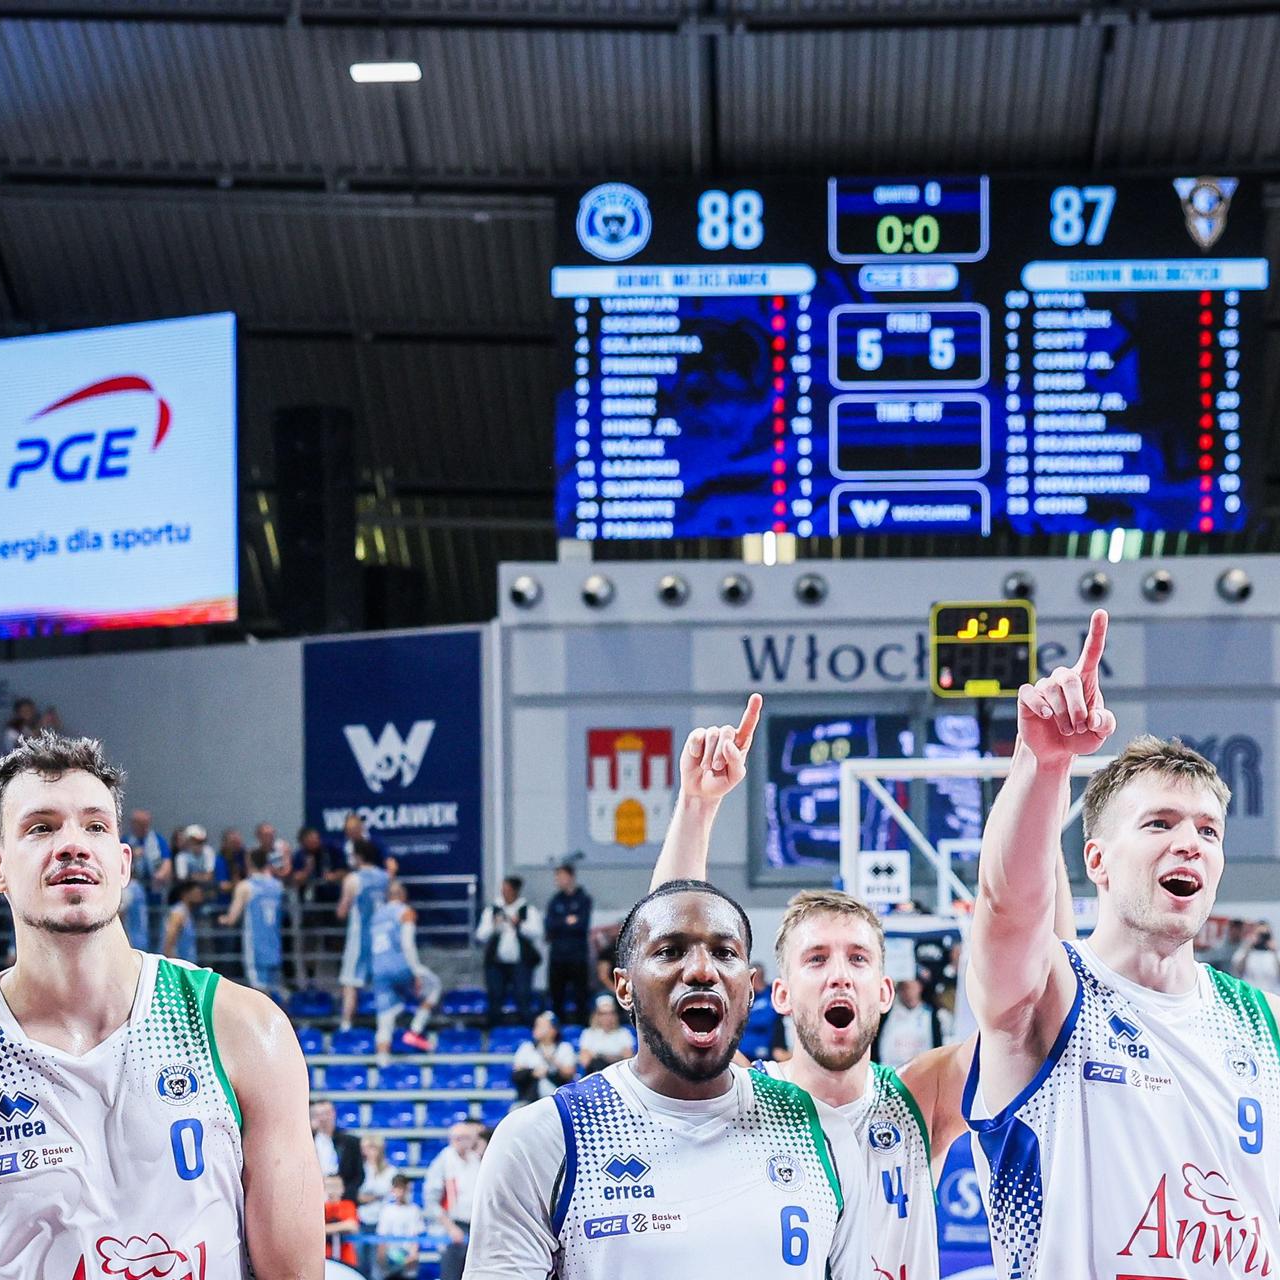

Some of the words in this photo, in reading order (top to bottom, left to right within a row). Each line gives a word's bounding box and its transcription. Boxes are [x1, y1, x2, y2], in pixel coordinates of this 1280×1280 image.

[697, 189, 764, 250] 88
[876, 214, 940, 254] 0:0
[1050, 185, 1117, 247] 87
[856, 328, 883, 371] 5
[928, 327, 956, 371] 5
[7, 427, 137, 489] PGE
[65, 529, 102, 553] dla
[111, 522, 191, 552] sportu
[160, 1065, 191, 1079] ANWIL
[1089, 1065, 1122, 1080] PGE
[1144, 1074, 1173, 1085] Basket
[1237, 1096, 1264, 1155] 9
[42, 1146, 74, 1156] Basket
[43, 1156, 63, 1166] Liga
[603, 1183, 655, 1200] errea
[881, 1166, 909, 1219] 4
[590, 1220, 624, 1235] PGE
[651, 1213, 681, 1223] Basket
[651, 1221, 672, 1231] Liga
[781, 1205, 810, 1266] 6
[1116, 1173, 1273, 1277] Anwil
